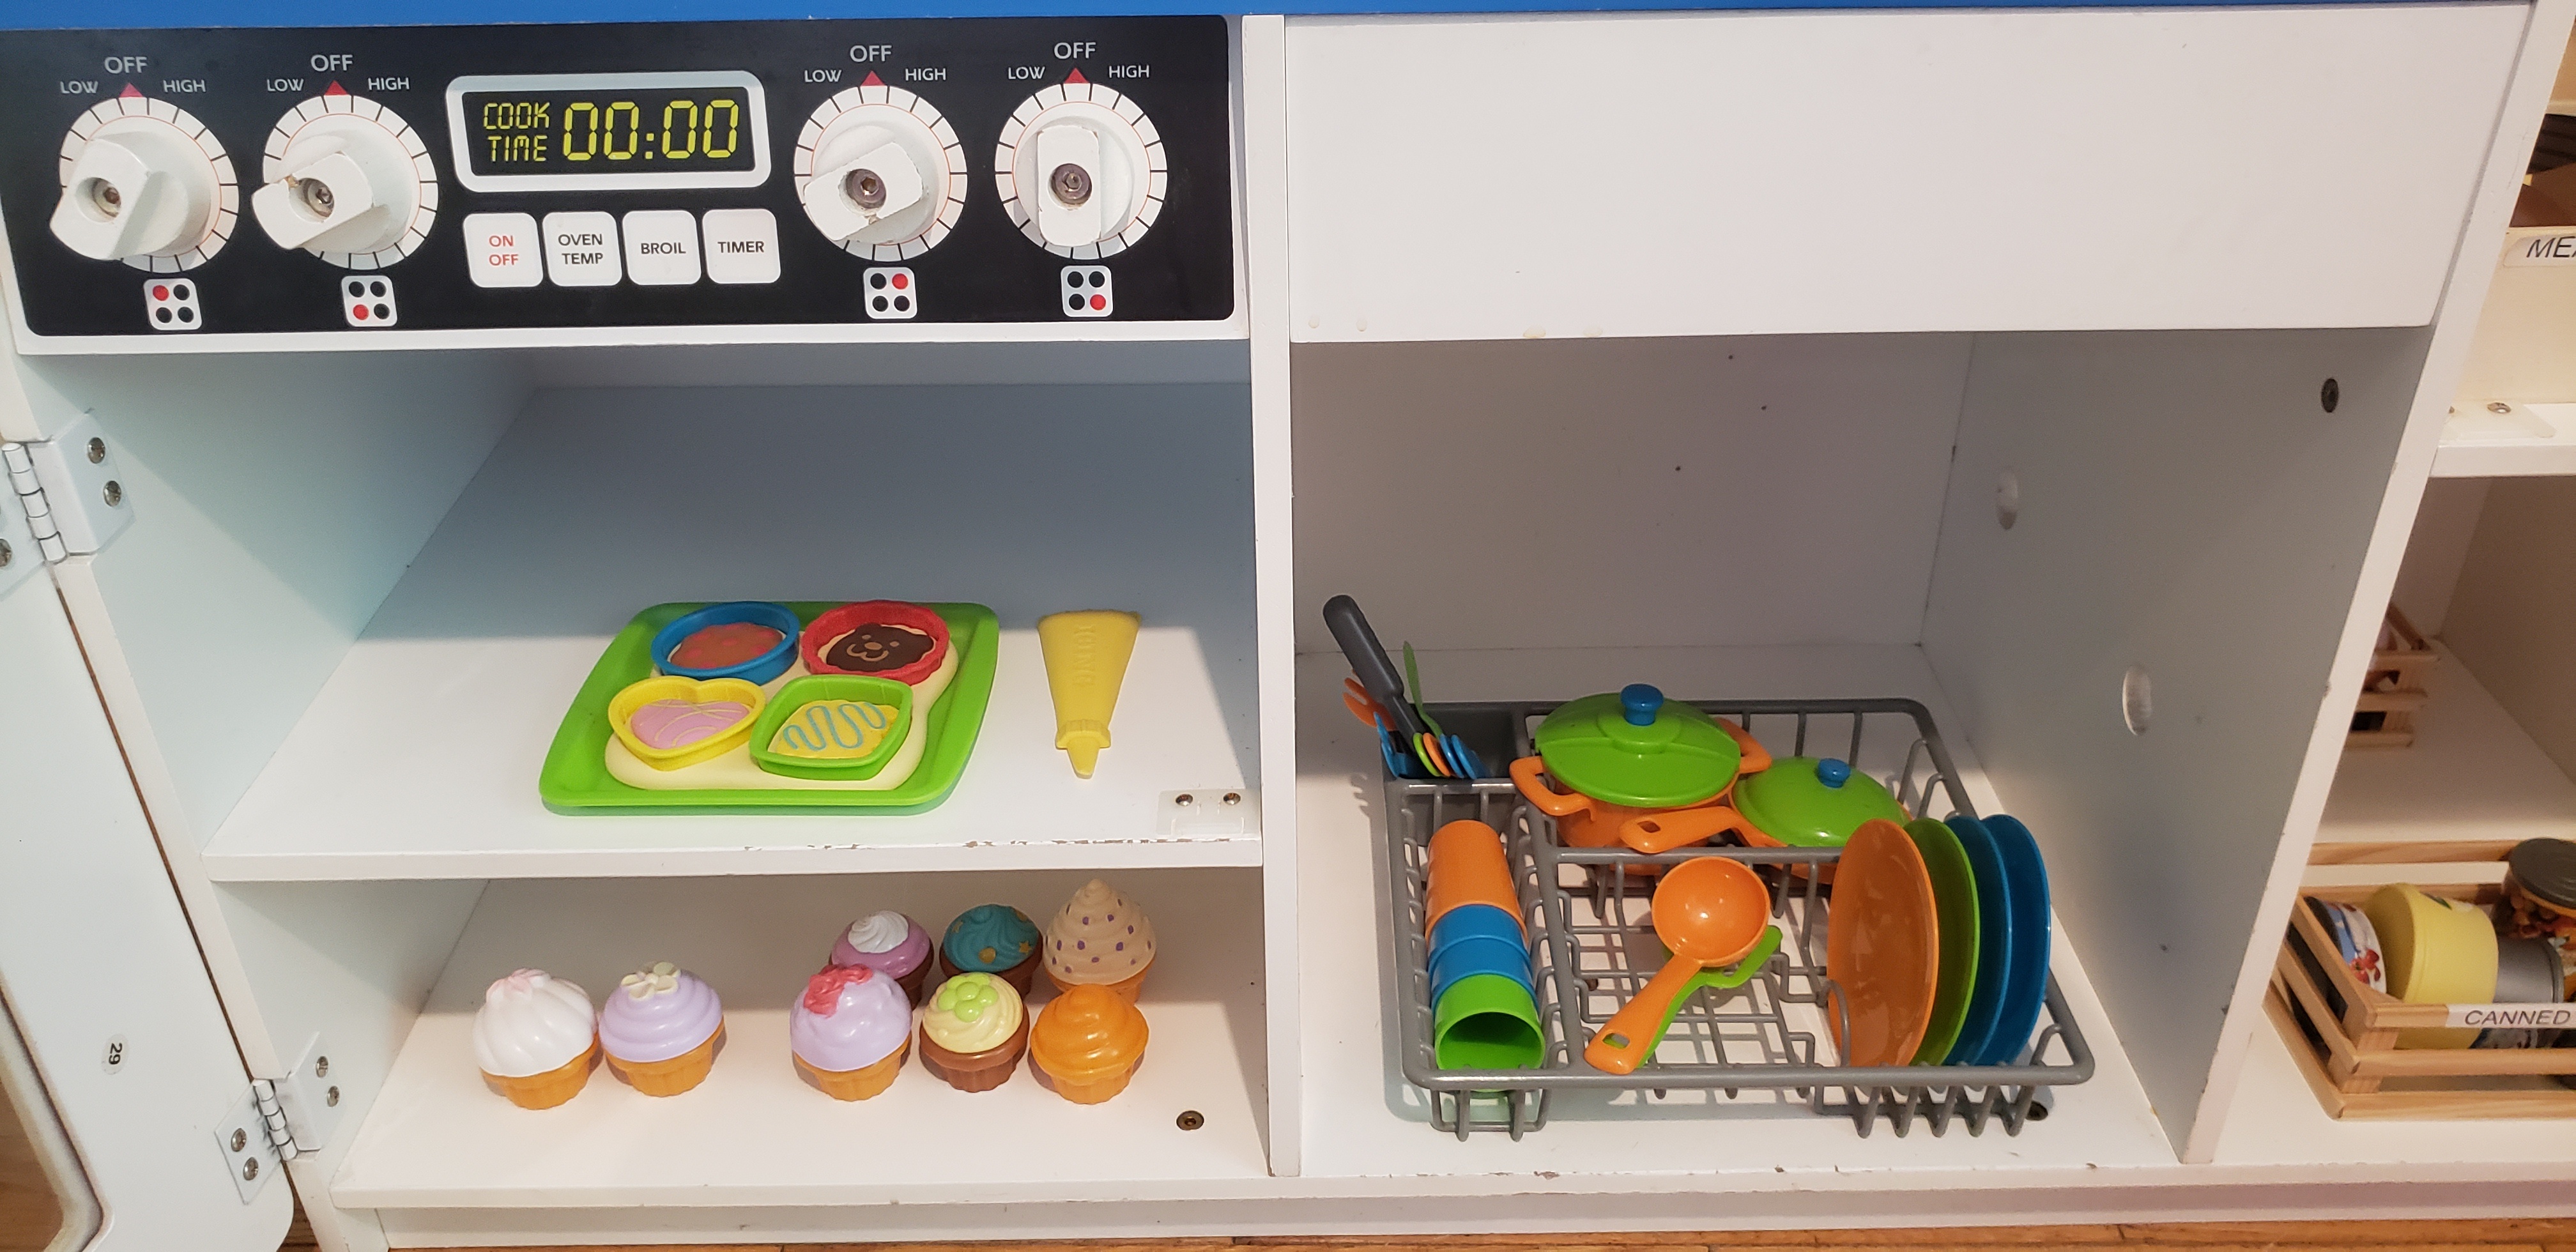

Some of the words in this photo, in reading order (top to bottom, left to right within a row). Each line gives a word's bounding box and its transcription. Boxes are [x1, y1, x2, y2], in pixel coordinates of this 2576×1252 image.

[850, 45, 893, 63] OFF
[1054, 42, 1096, 59] OFF
[104, 56, 148, 74] OFF
[310, 54, 353, 72] OFF
[804, 70, 842, 83] LOW
[905, 68, 947, 81] HIGH
[1008, 66, 1046, 80] LOW
[1108, 65, 1150, 78] HIGH
[60, 80, 98, 94] LOW
[163, 79, 206, 93] HIGH
[266, 79, 304, 92] LOW
[368, 77, 410, 91] HIGH
[483, 102, 550, 130] COOK
[562, 99, 739, 161] 00:00
[487, 134, 547, 162] TIME
[489, 235, 514, 247] ON
[558, 233, 603, 246] OVEN
[641, 242, 686, 254] BROIL
[717, 241, 764, 253] TIMER
[2526, 236, 2576, 258] ME
[489, 254, 519, 266] OFF
[562, 252, 604, 265] TEMP
[2465, 1010, 2571, 1025] CANNED
[108, 1042, 123, 1065] 29
